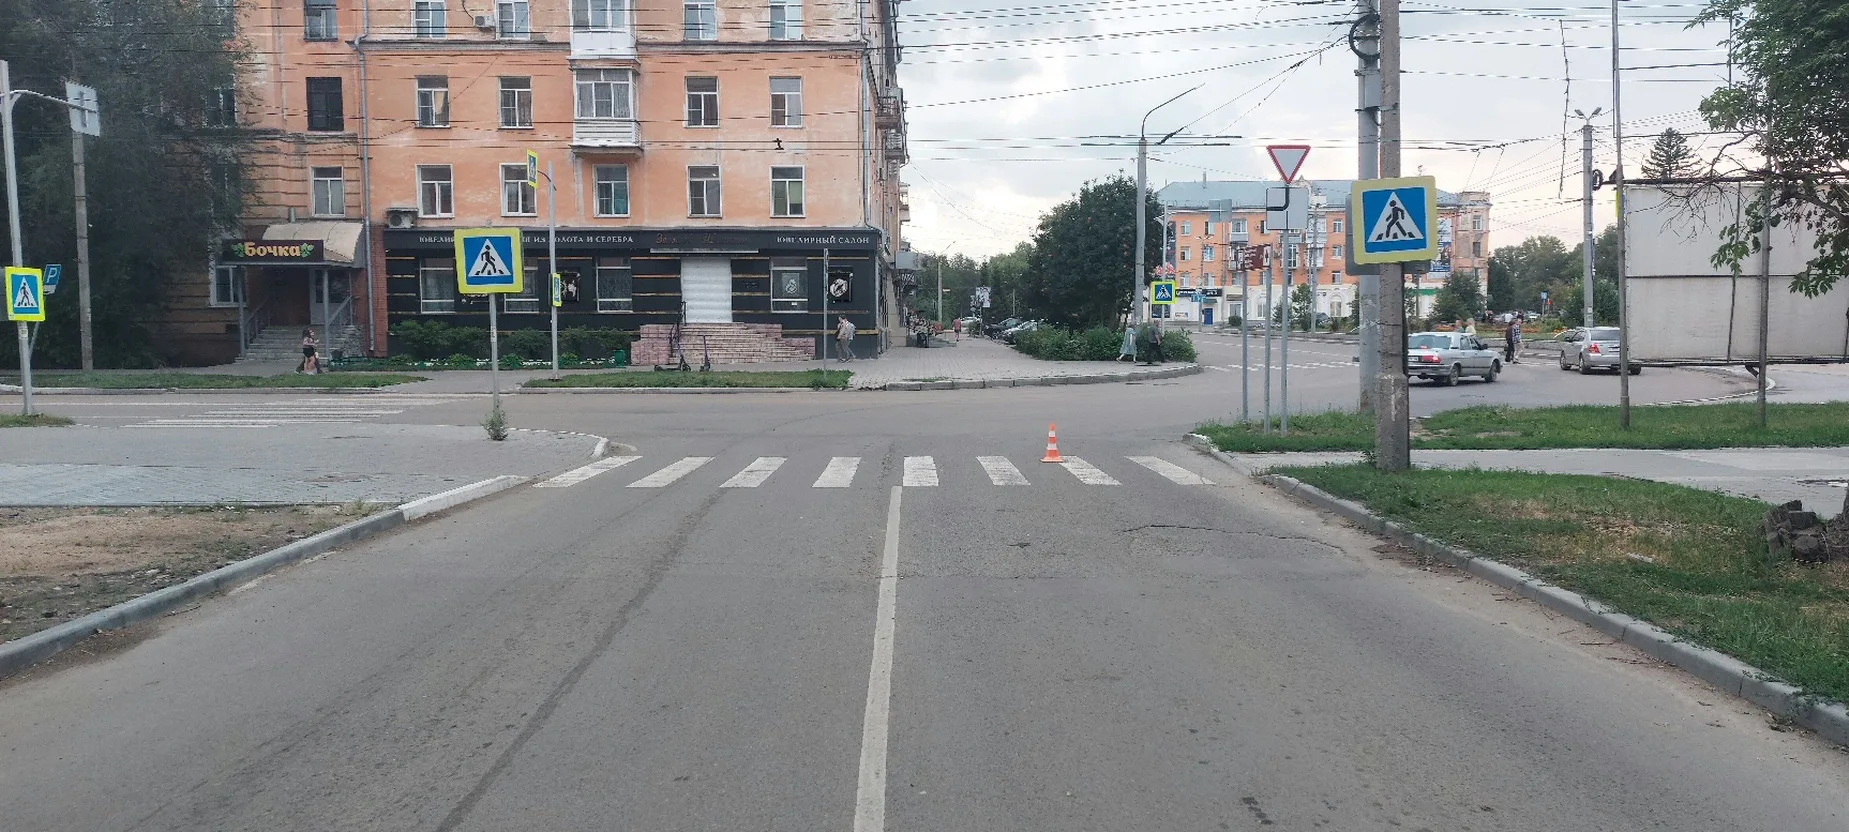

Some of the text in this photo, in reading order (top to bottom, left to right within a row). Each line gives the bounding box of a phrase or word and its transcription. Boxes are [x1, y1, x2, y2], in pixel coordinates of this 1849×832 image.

[776, 235, 869, 244] ЮВЕЛИРНЫЙ САЛОН
[243, 241, 301, 257] Бочка
